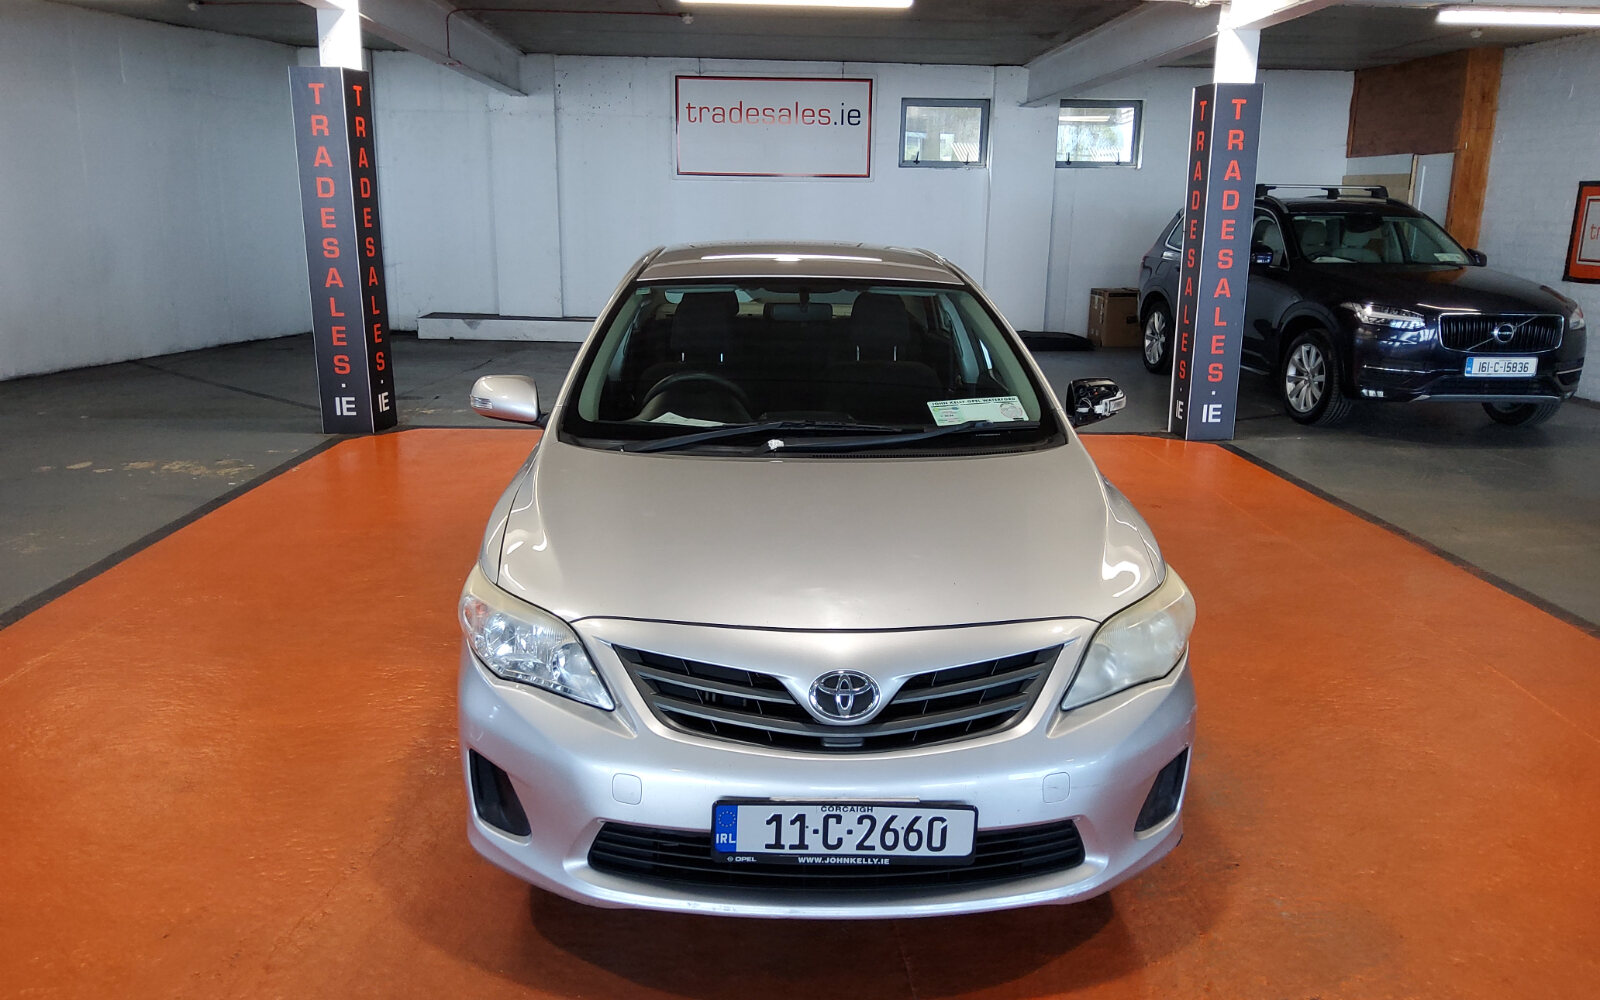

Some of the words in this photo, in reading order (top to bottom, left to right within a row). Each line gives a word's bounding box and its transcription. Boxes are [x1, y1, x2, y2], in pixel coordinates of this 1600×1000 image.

[685, 100, 861, 127] tradesales.ie
[1477, 361, 1530, 373] 161-C-15836
[715, 833, 737, 844] IRL
[734, 855, 757, 863] OPEL
[797, 855, 890, 865] WWW.JOHNKELLY.IE
